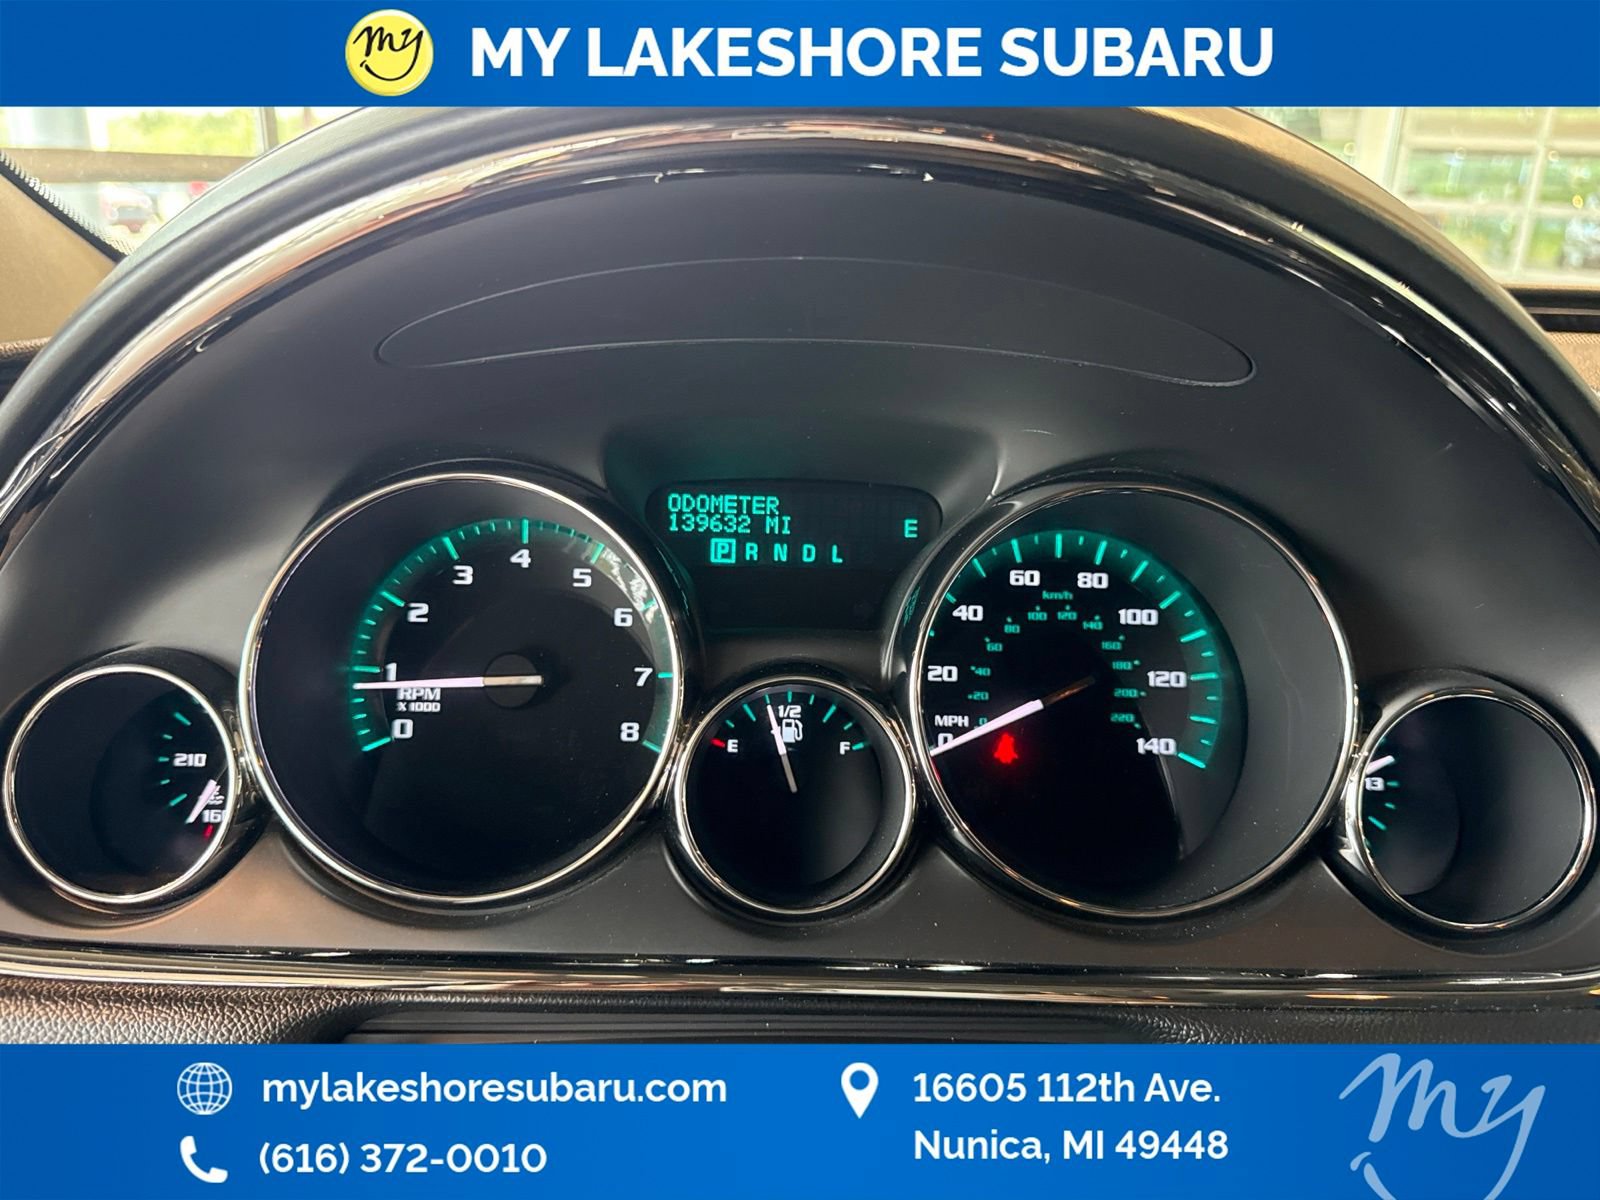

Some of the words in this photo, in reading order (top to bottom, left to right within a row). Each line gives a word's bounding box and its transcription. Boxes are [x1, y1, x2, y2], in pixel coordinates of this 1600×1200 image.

[668, 494, 779, 515] ODOMETER
[669, 515, 750, 533] 139632
[766, 516, 791, 534] MI
[904, 520, 918, 538] E
[510, 549, 531, 568] 4
[746, 542, 758, 561] R
[774, 544, 787, 562] N
[802, 544, 816, 562] D
[832, 545, 842, 563] L
[453, 565, 473, 585] 3
[573, 568, 592, 588] 5
[1009, 570, 1040, 587] 60
[1077, 572, 1108, 589] 80
[1042, 590, 1073, 601] km/h
[407, 602, 429, 623] 2
[614, 608, 633, 627] 6
[952, 605, 983, 622] 40
[1027, 612, 1047, 621] 100
[1057, 611, 1077, 620] 120
[1118, 609, 1158, 626] 100
[1004, 624, 1020, 633] 80
[1083, 621, 1103, 631] 140
[986, 643, 1003, 652] 60
[1101, 641, 1121, 650] 160
[385, 662, 397, 682] 1
[975, 667, 991, 676] 40
[1112, 661, 1132, 670] 180
[634, 668, 653, 687] 7
[928, 666, 958, 682] 20
[1147, 671, 1187, 688] 120
[397, 687, 441, 701] RPM
[973, 691, 988, 700] 20
[1114, 689, 1138, 698] 200
[409, 702, 440, 712] 1000
[778, 704, 801, 718] 1/2
[935, 716, 969, 727] MPH
[1110, 713, 1135, 722] 220
[392, 719, 414, 739] 0
[620, 722, 640, 742] 8
[727, 740, 738, 753] E
[840, 742, 850, 754] F
[938, 734, 954, 747] 0
[1136, 738, 1177, 756] 140
[173, 753, 207, 767] 210
